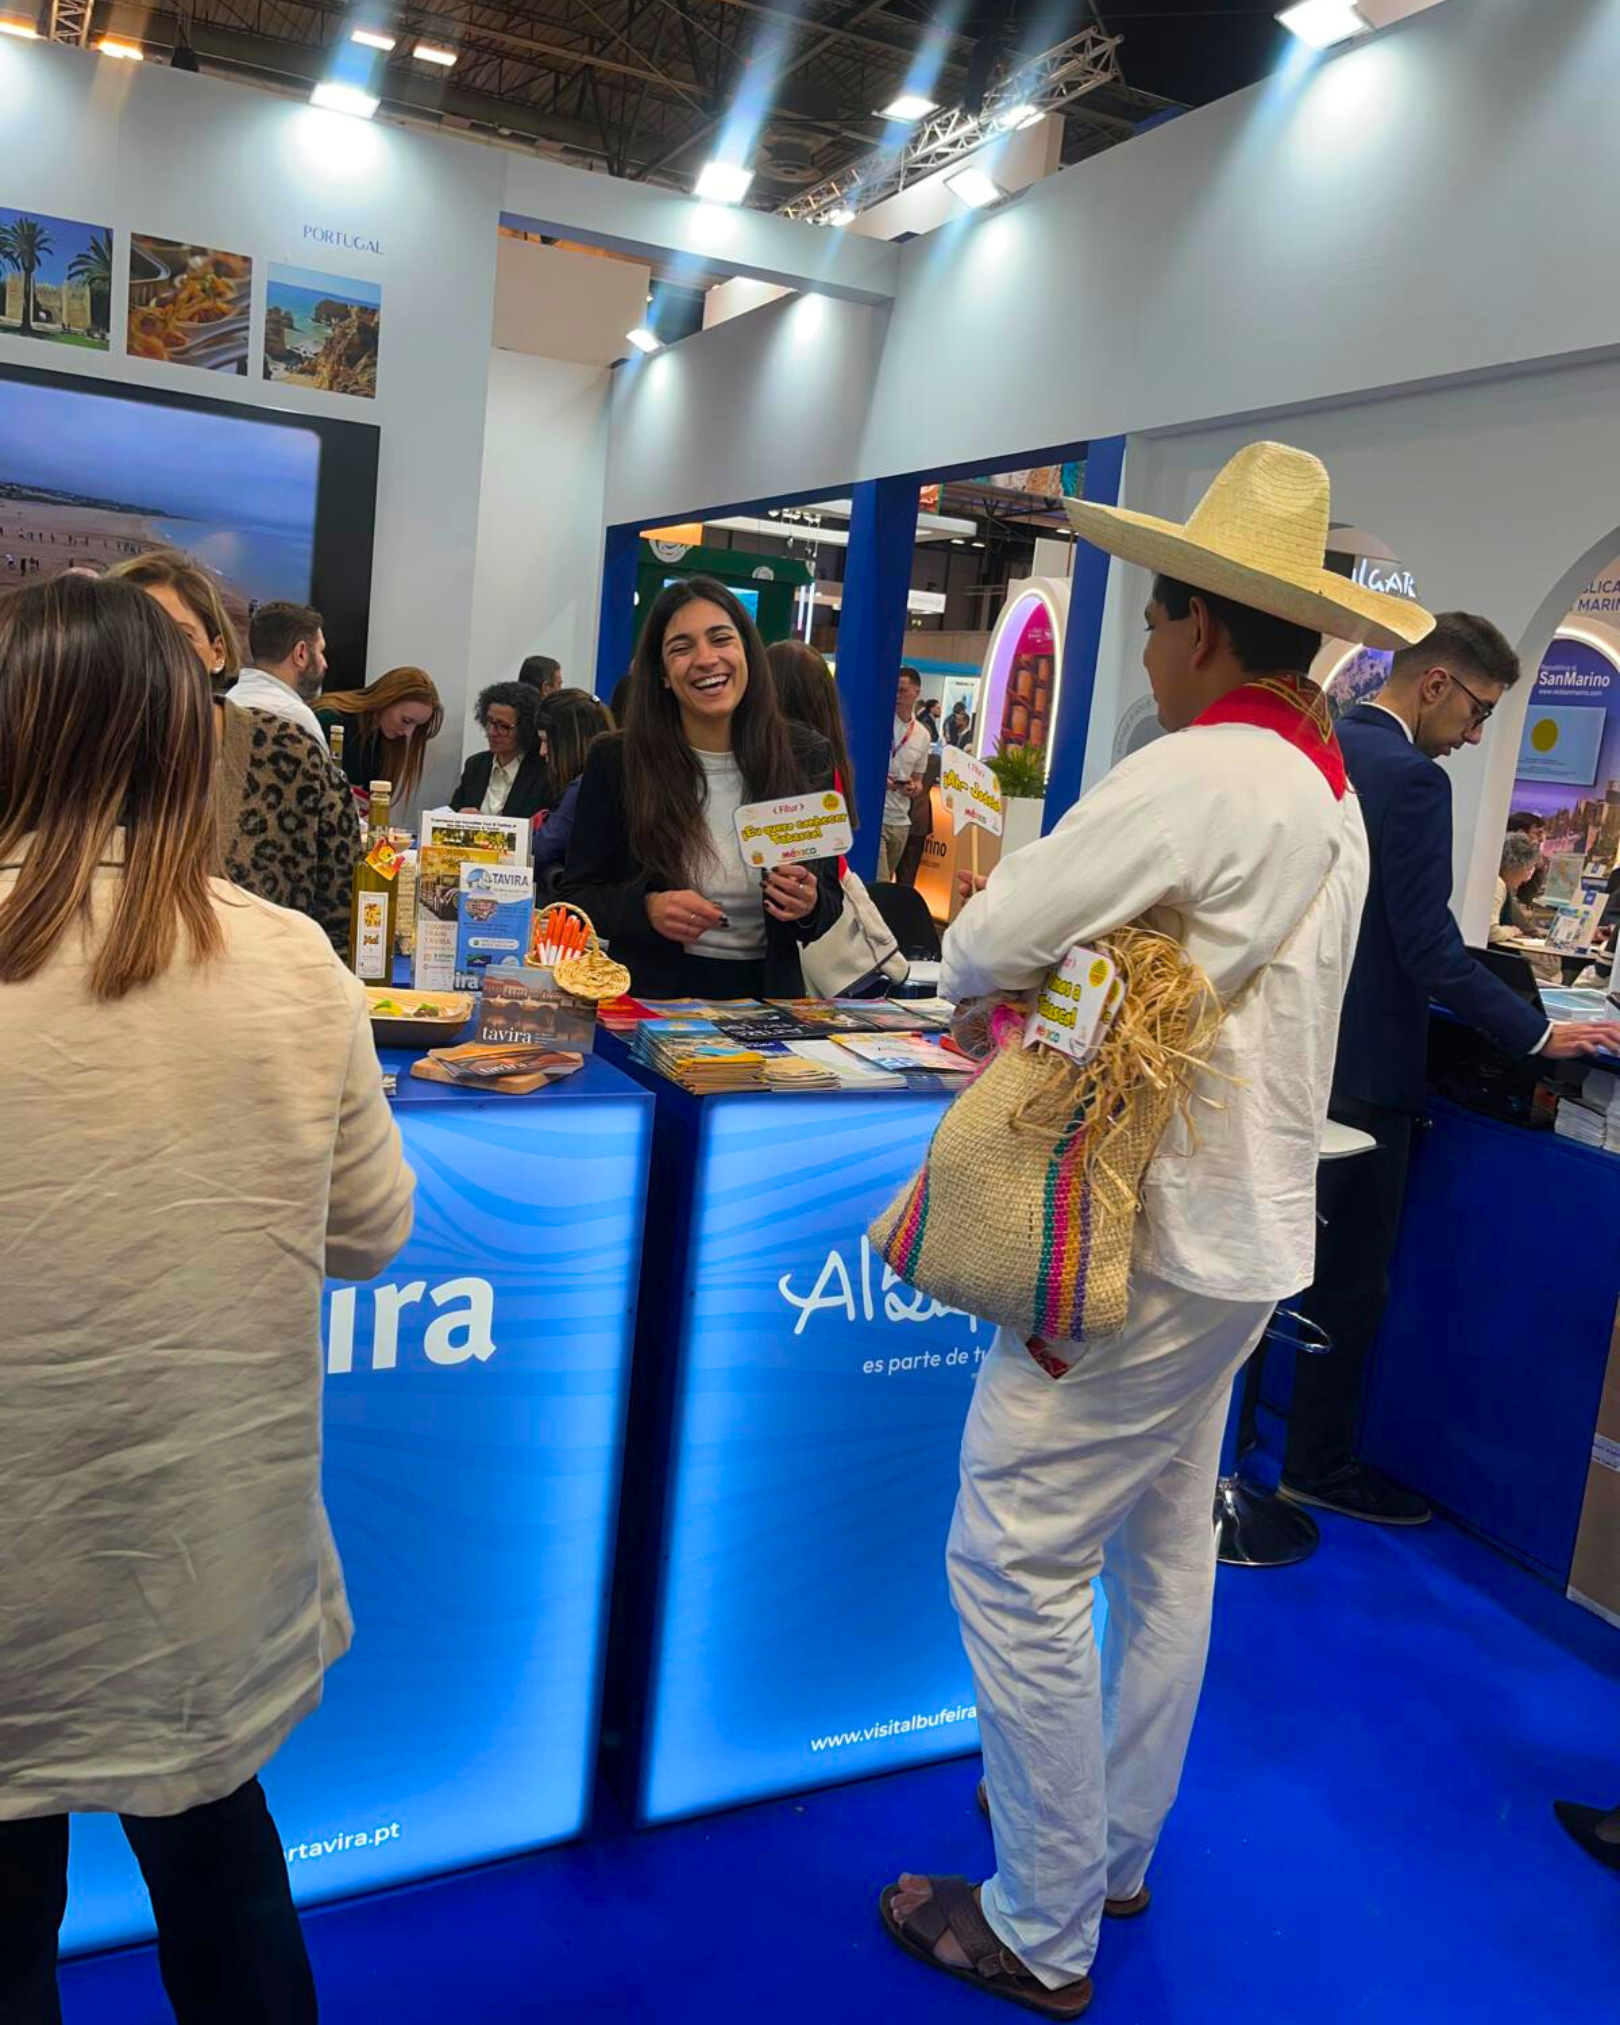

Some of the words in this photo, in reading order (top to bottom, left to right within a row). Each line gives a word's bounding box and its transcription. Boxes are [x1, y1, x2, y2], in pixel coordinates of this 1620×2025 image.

[302, 223, 387, 256] PORTUGAL
[1538, 671, 1610, 688] SanMarino
[779, 804, 798, 815] Fitur
[492, 872, 529, 887] TAVIRA
[482, 1026, 533, 1044] tavira
[862, 1358, 884, 1374] es
[888, 1350, 942, 1376] parte
[946, 1347, 969, 1366] de
